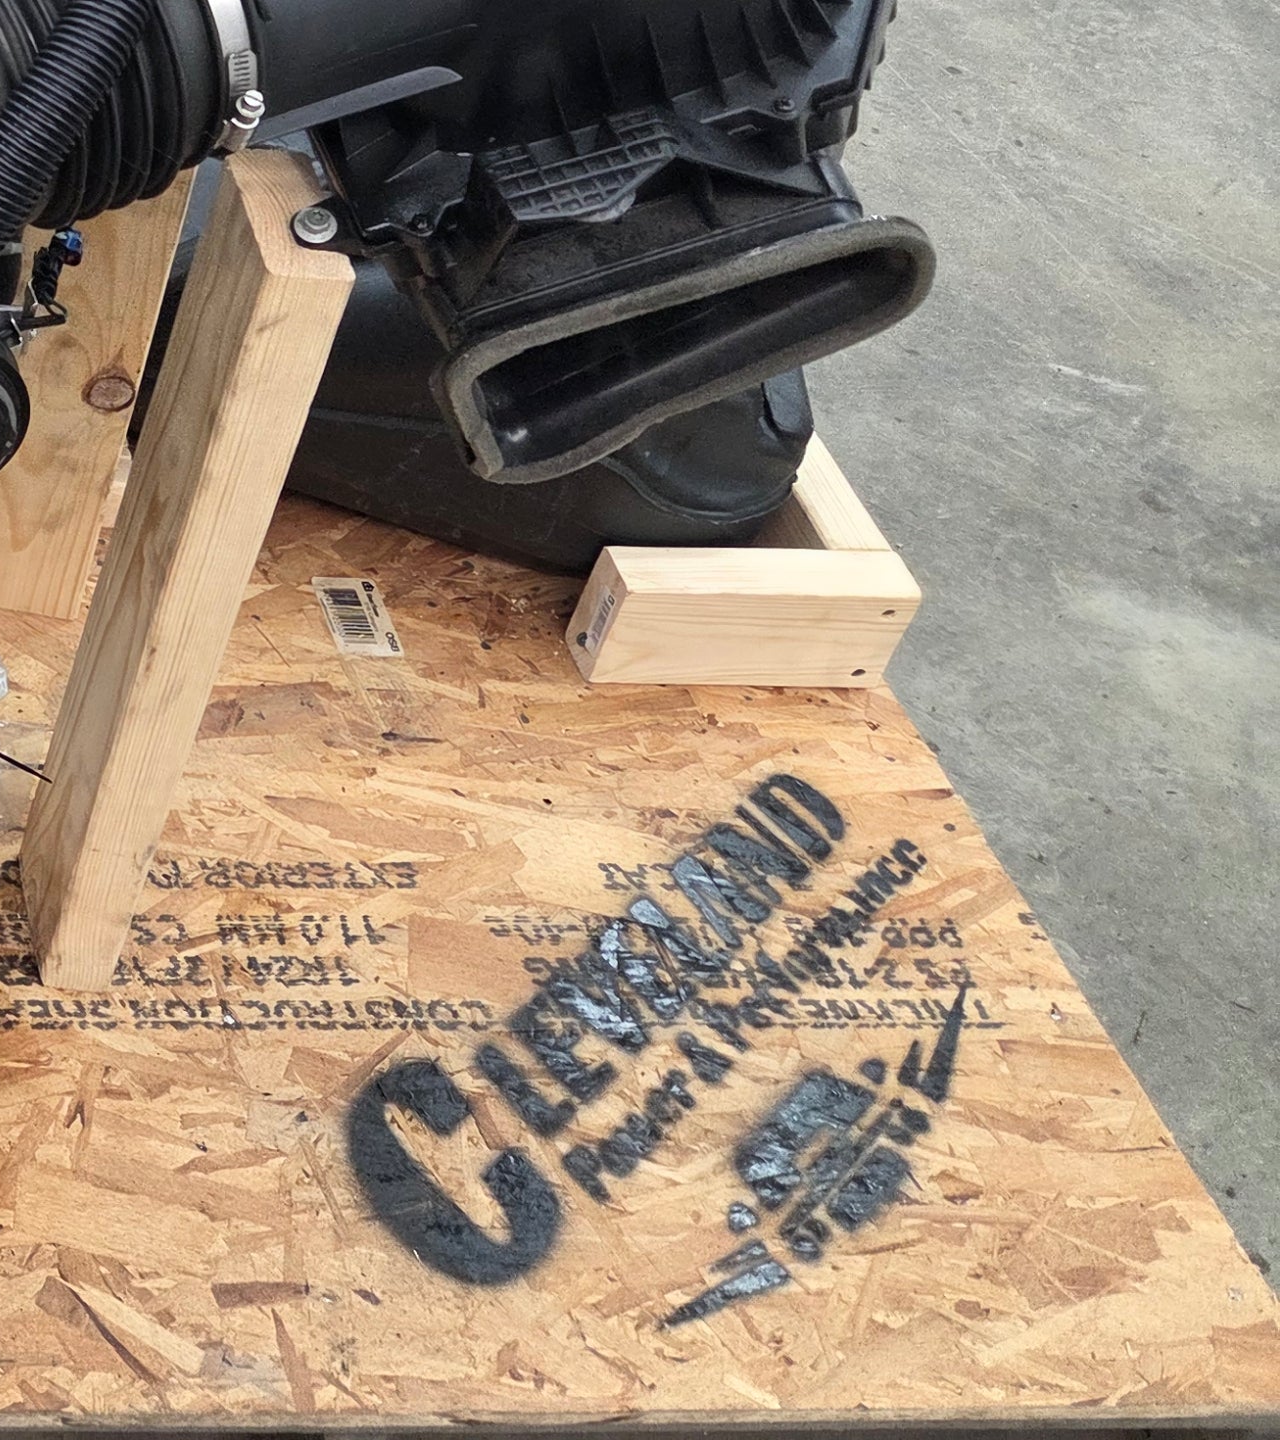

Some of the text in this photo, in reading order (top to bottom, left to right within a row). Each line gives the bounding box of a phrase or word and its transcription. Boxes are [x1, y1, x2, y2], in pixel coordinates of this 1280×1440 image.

[345, 772, 846, 1288] CLEVELAND
[560, 1068, 696, 1203] Power
[681, 1029, 735, 1087] &
